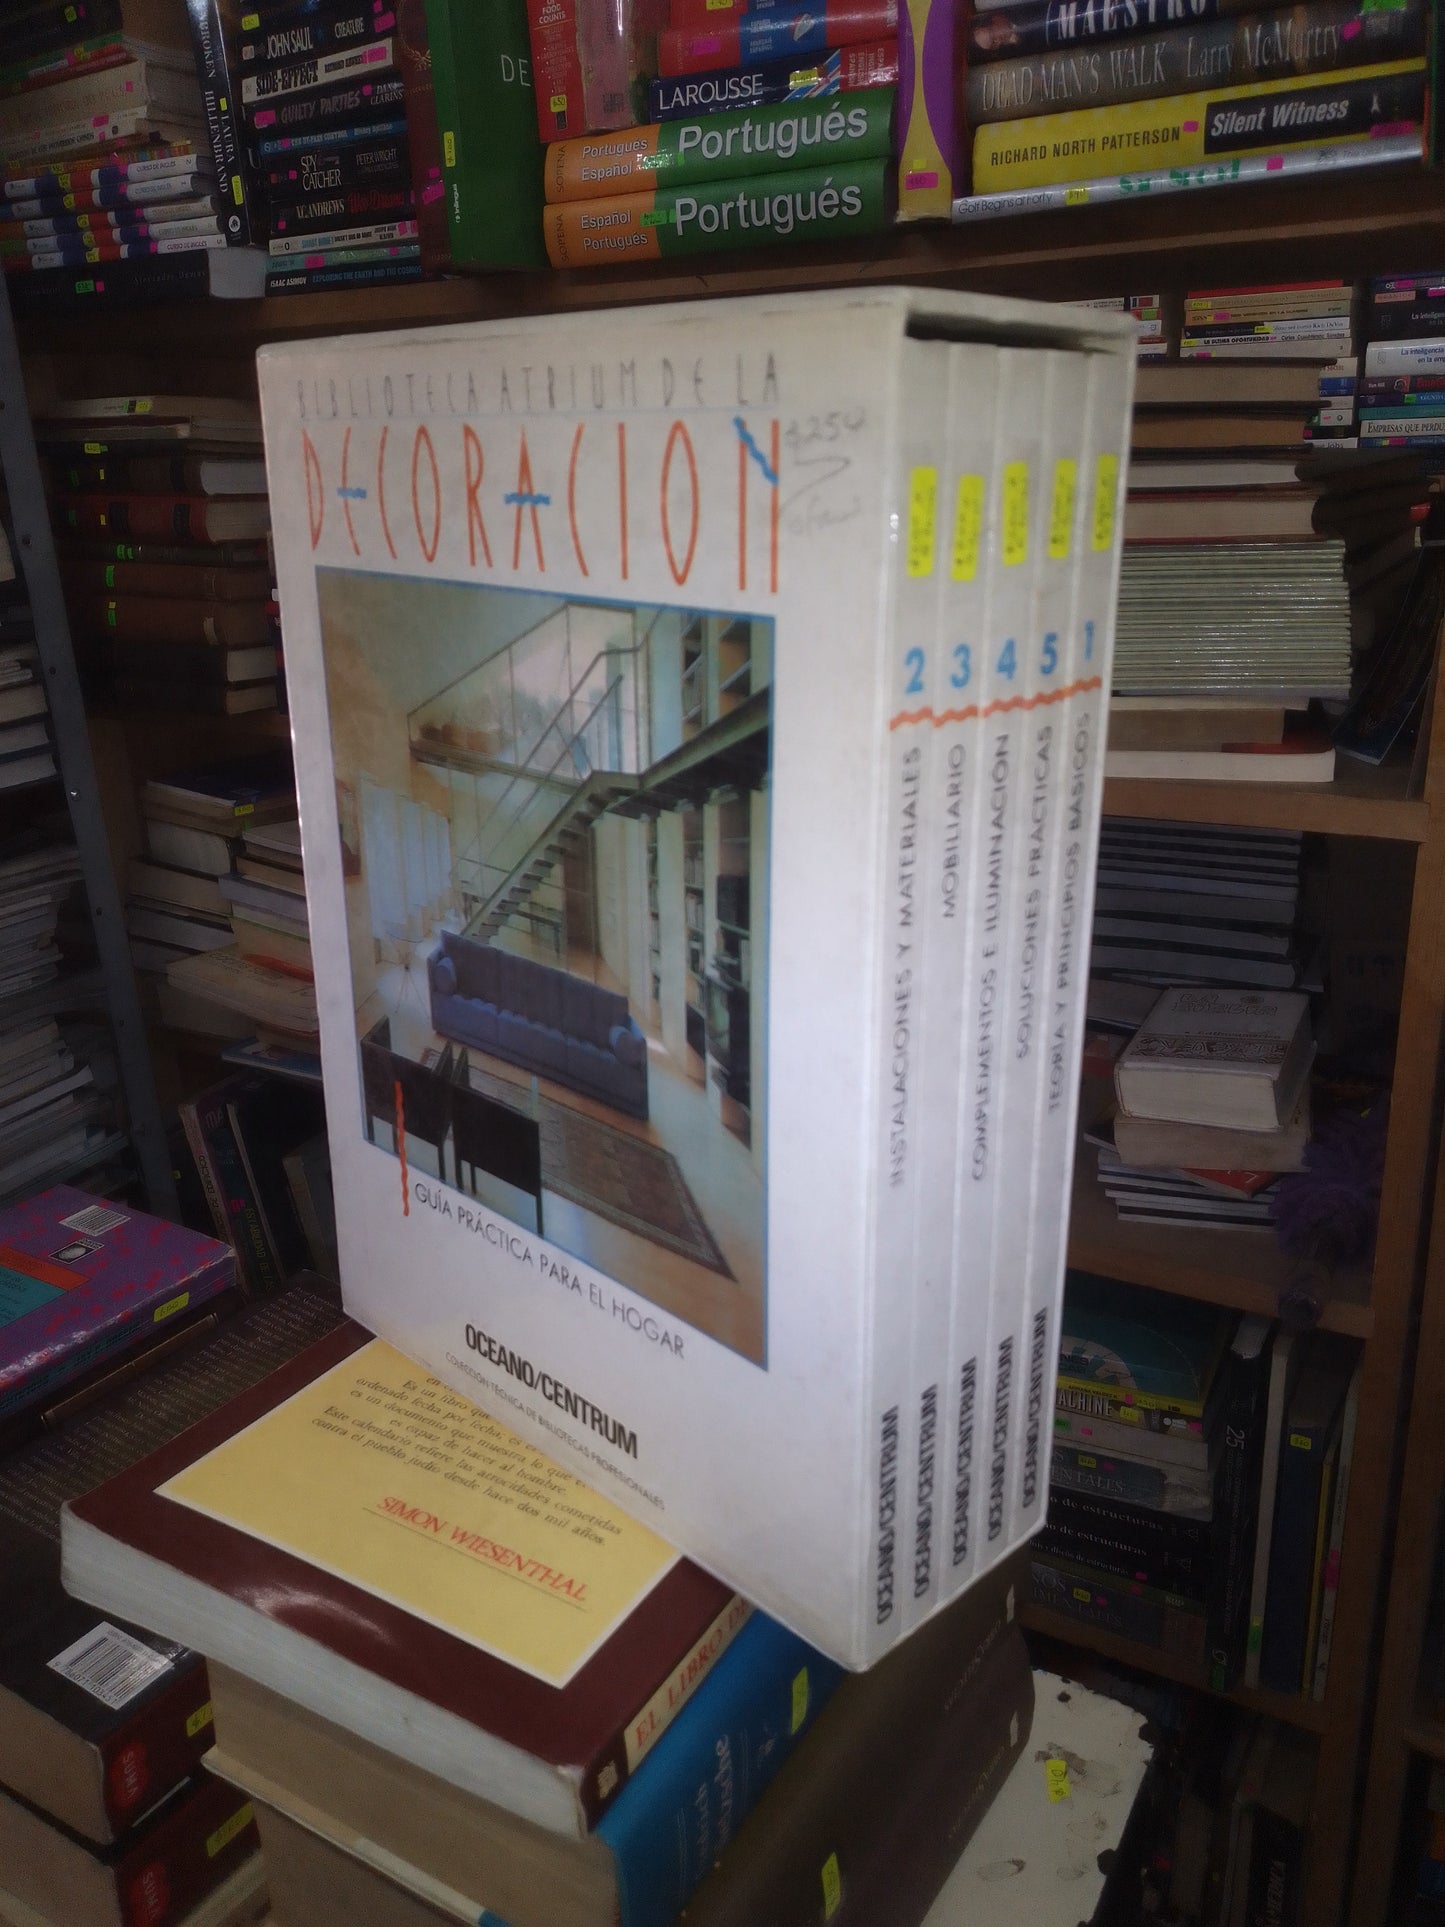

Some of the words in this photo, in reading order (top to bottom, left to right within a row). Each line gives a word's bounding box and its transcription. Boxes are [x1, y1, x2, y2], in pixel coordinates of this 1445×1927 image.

[334, 17, 365, 38] CREATURE
[539, 11, 566, 24] COUNTS
[266, 31, 290, 60] JOHN
[289, 27, 314, 54] SAUL
[256, 59, 319, 97] SIDE-EFFECT
[659, 73, 765, 111] LAROUSSE
[982, 66, 1033, 112] DEAD
[1110, 40, 1168, 89] WALK
[1187, 36, 1234, 77] Larry
[319, 89, 361, 116] PARTIES
[1211, 111, 1266, 138] Silent
[1272, 99, 1349, 129] Witness
[204, 91, 229, 193] HILLENBRAND
[220, 113, 235, 164] LAURA
[582, 139, 648, 160] Portugués
[678, 101, 868, 160] Portugués
[990, 144, 1047, 166] RICHARD
[1052, 138, 1096, 158] NORTH
[1102, 126, 1181, 152] PATTERSON
[301, 154, 318, 175] SPY
[302, 168, 342, 190] CATCHER
[556, 144, 567, 193] SOPENA
[581, 164, 632, 182] Español
[308, 198, 345, 218] ANDREWS
[581, 210, 632, 229] Español
[674, 176, 863, 236] Portugués
[958, 199, 980, 215] Golf
[554, 213, 569, 262] SOPENA
[583, 232, 648, 252] Portugués
[297, 370, 480, 420] BIBLIOTECA
[661, 357, 704, 407] DE
[735, 351, 780, 407] LA
[1367, 422, 1403, 434] EMPRESAS
[1404, 423, 1420, 433] QUE
[302, 416, 780, 594] DECORACION
[996, 637, 1017, 681] 4
[1040, 631, 1059, 676] 5
[1084, 620, 1095, 663] 1
[904, 646, 925, 694] 2
[950, 643, 971, 689] 3
[898, 747, 922, 928] MATERIALES
[941, 743, 967, 919] MOBILIARIO
[897, 942, 911, 959] Y
[982, 943, 998, 960] E
[1015, 888, 1041, 1060] SOLUCIONES
[889, 968, 912, 1188] INSTALACIONES
[971, 968, 997, 1182] COMPLEMENTOS
[414, 1179, 454, 1219] GUÍA
[457, 1203, 534, 1264] PRÁCTICA
[539, 1253, 583, 1297] PARA
[589, 1282, 606, 1312] EL
[611, 1296, 685, 1360] HOGAR
[356, 1377, 409, 1401] ordenado
[411, 1396, 442, 1415] fecha
[442, 1410, 467, 1425] por
[508, 1436, 521, 1447] es
[402, 1379, 418, 1392] Es
[421, 1388, 436, 1399] un
[441, 1393, 468, 1410] libro
[464, 1322, 639, 1460] OCEANO/CENTRUM
[1058, 1389, 1113, 1417] ACHINE
[351, 1389, 363, 1399] es
[366, 1395, 382, 1406] un
[384, 1401, 448, 1431] documento
[451, 1427, 475, 1442] que
[477, 1437, 527, 1464] muestra
[530, 1457, 544, 1470] lo
[389, 1418, 402, 1428] es
[406, 1424, 441, 1443] capaz
[443, 1438, 460, 1450] de
[461, 1445, 498, 1467] hacer
[498, 1462, 515, 1474] al
[1226, 1423, 1245, 1450] 25
[311, 1417, 349, 1437] contra
[350, 1431, 365, 1443] el
[361, 1437, 407, 1461] pueblo
[443, 1470, 481, 1491] desde
[482, 1485, 515, 1505] hace
[516, 1501, 541, 1518] dos
[544, 1512, 570, 1529] mil
[323, 1405, 350, 1422] Este
[351, 1416, 413, 1447] calendario
[414, 1444, 455, 1464] refiere
[456, 1458, 475, 1474] las
[476, 1467, 552, 1505] atrocidades
[554, 1501, 624, 1536] cometidas
[1062, 1497, 1079, 1510] de
[1083, 1504, 1164, 1532] estructuras
[376, 1495, 448, 1534] SIMON
[450, 1525, 589, 1602] WIESENTHAL
[1060, 1525, 1075, 1537] de
[1077, 1530, 1148, 1557] estructuras
[667, 1626, 725, 1706] LIBRO
